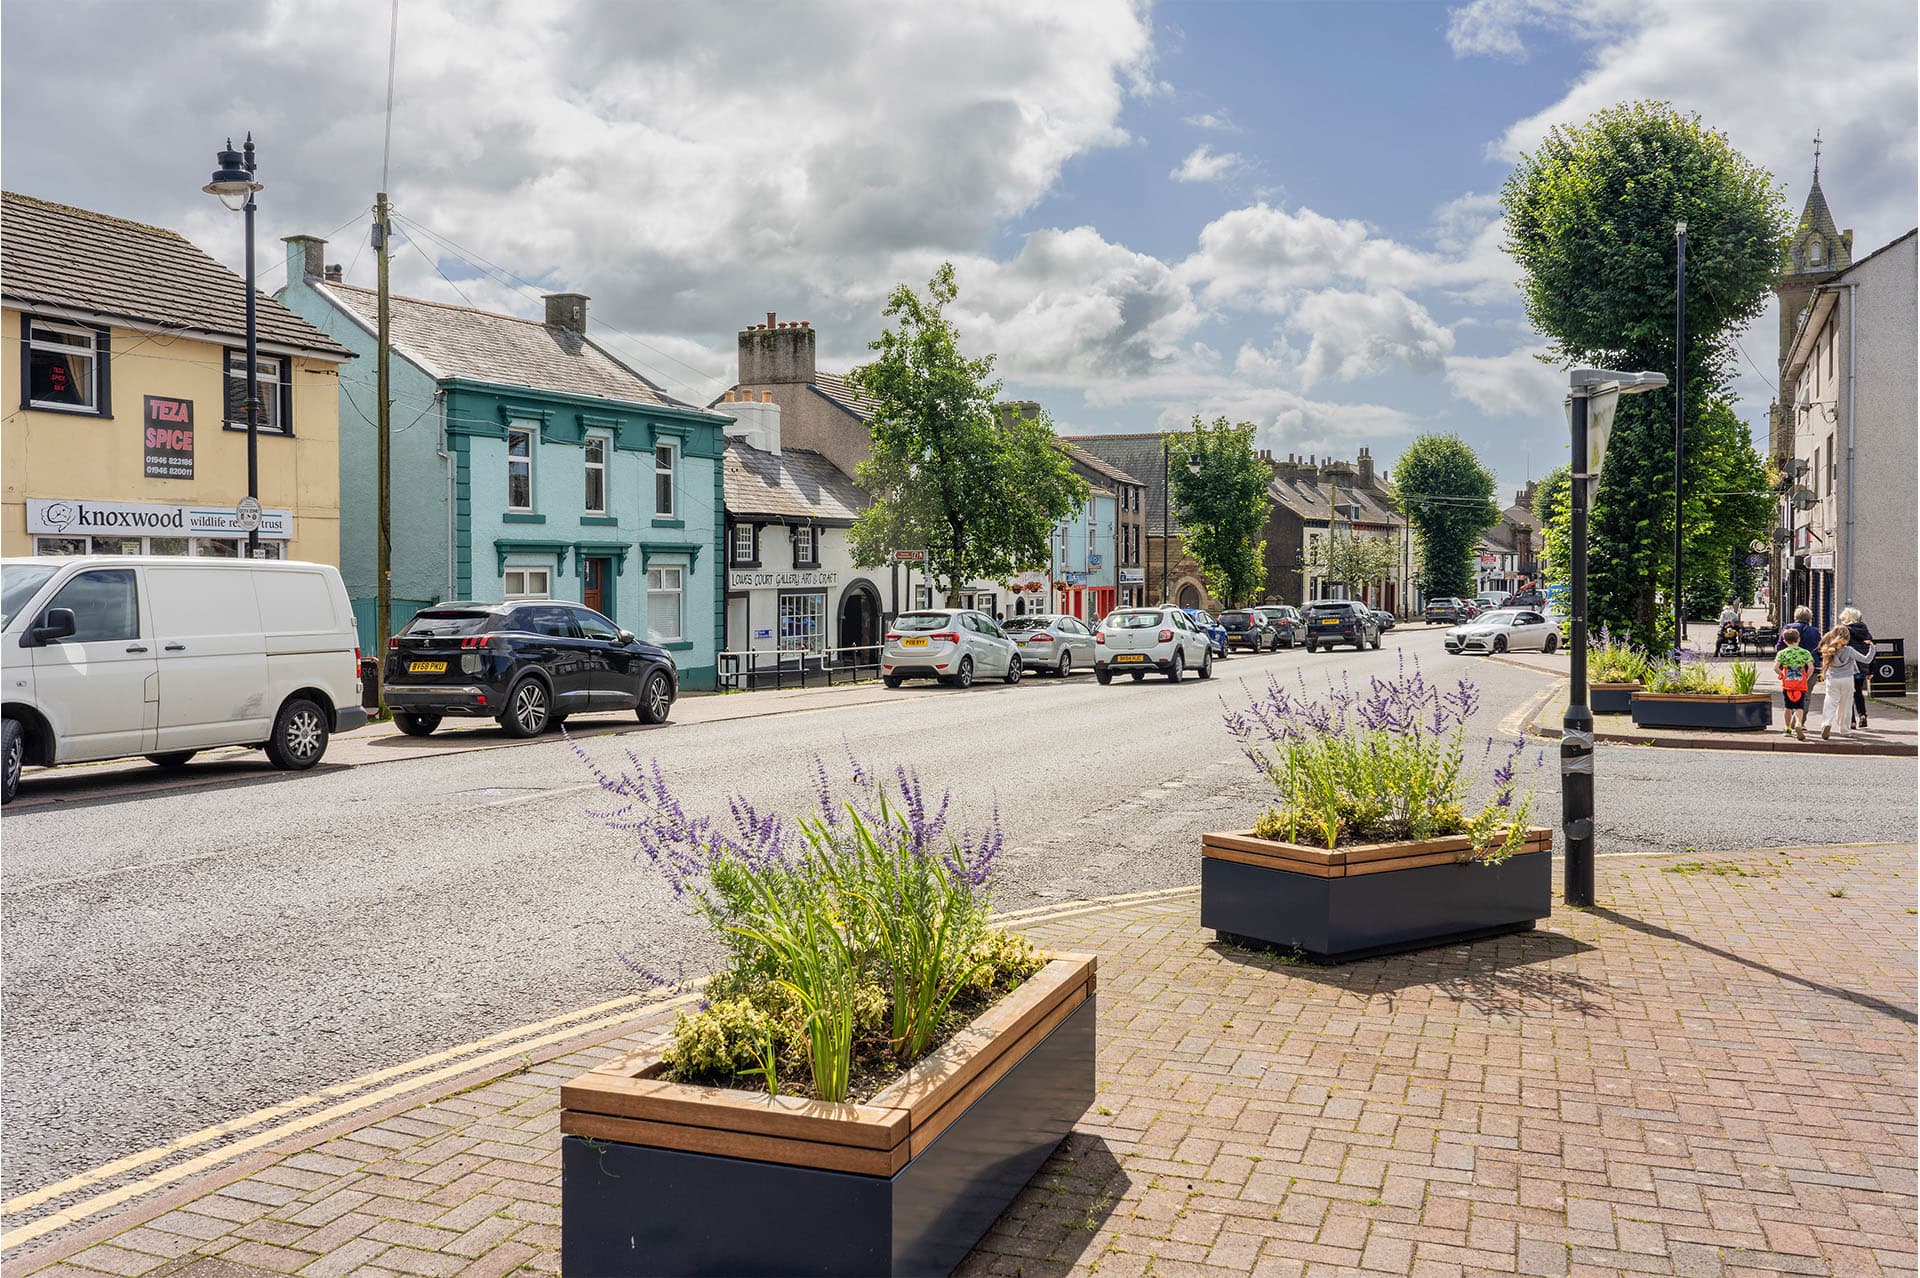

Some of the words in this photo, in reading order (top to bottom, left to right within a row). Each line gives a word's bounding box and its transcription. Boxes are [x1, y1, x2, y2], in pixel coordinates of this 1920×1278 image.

[150, 400, 189, 422] TEZA
[146, 427, 193, 450] SPICE
[145, 455, 168, 464] 01946
[146, 465, 168, 474] 01946
[77, 504, 184, 528] knoxwood
[190, 516, 226, 527] wildlife
[261, 520, 283, 529] trust
